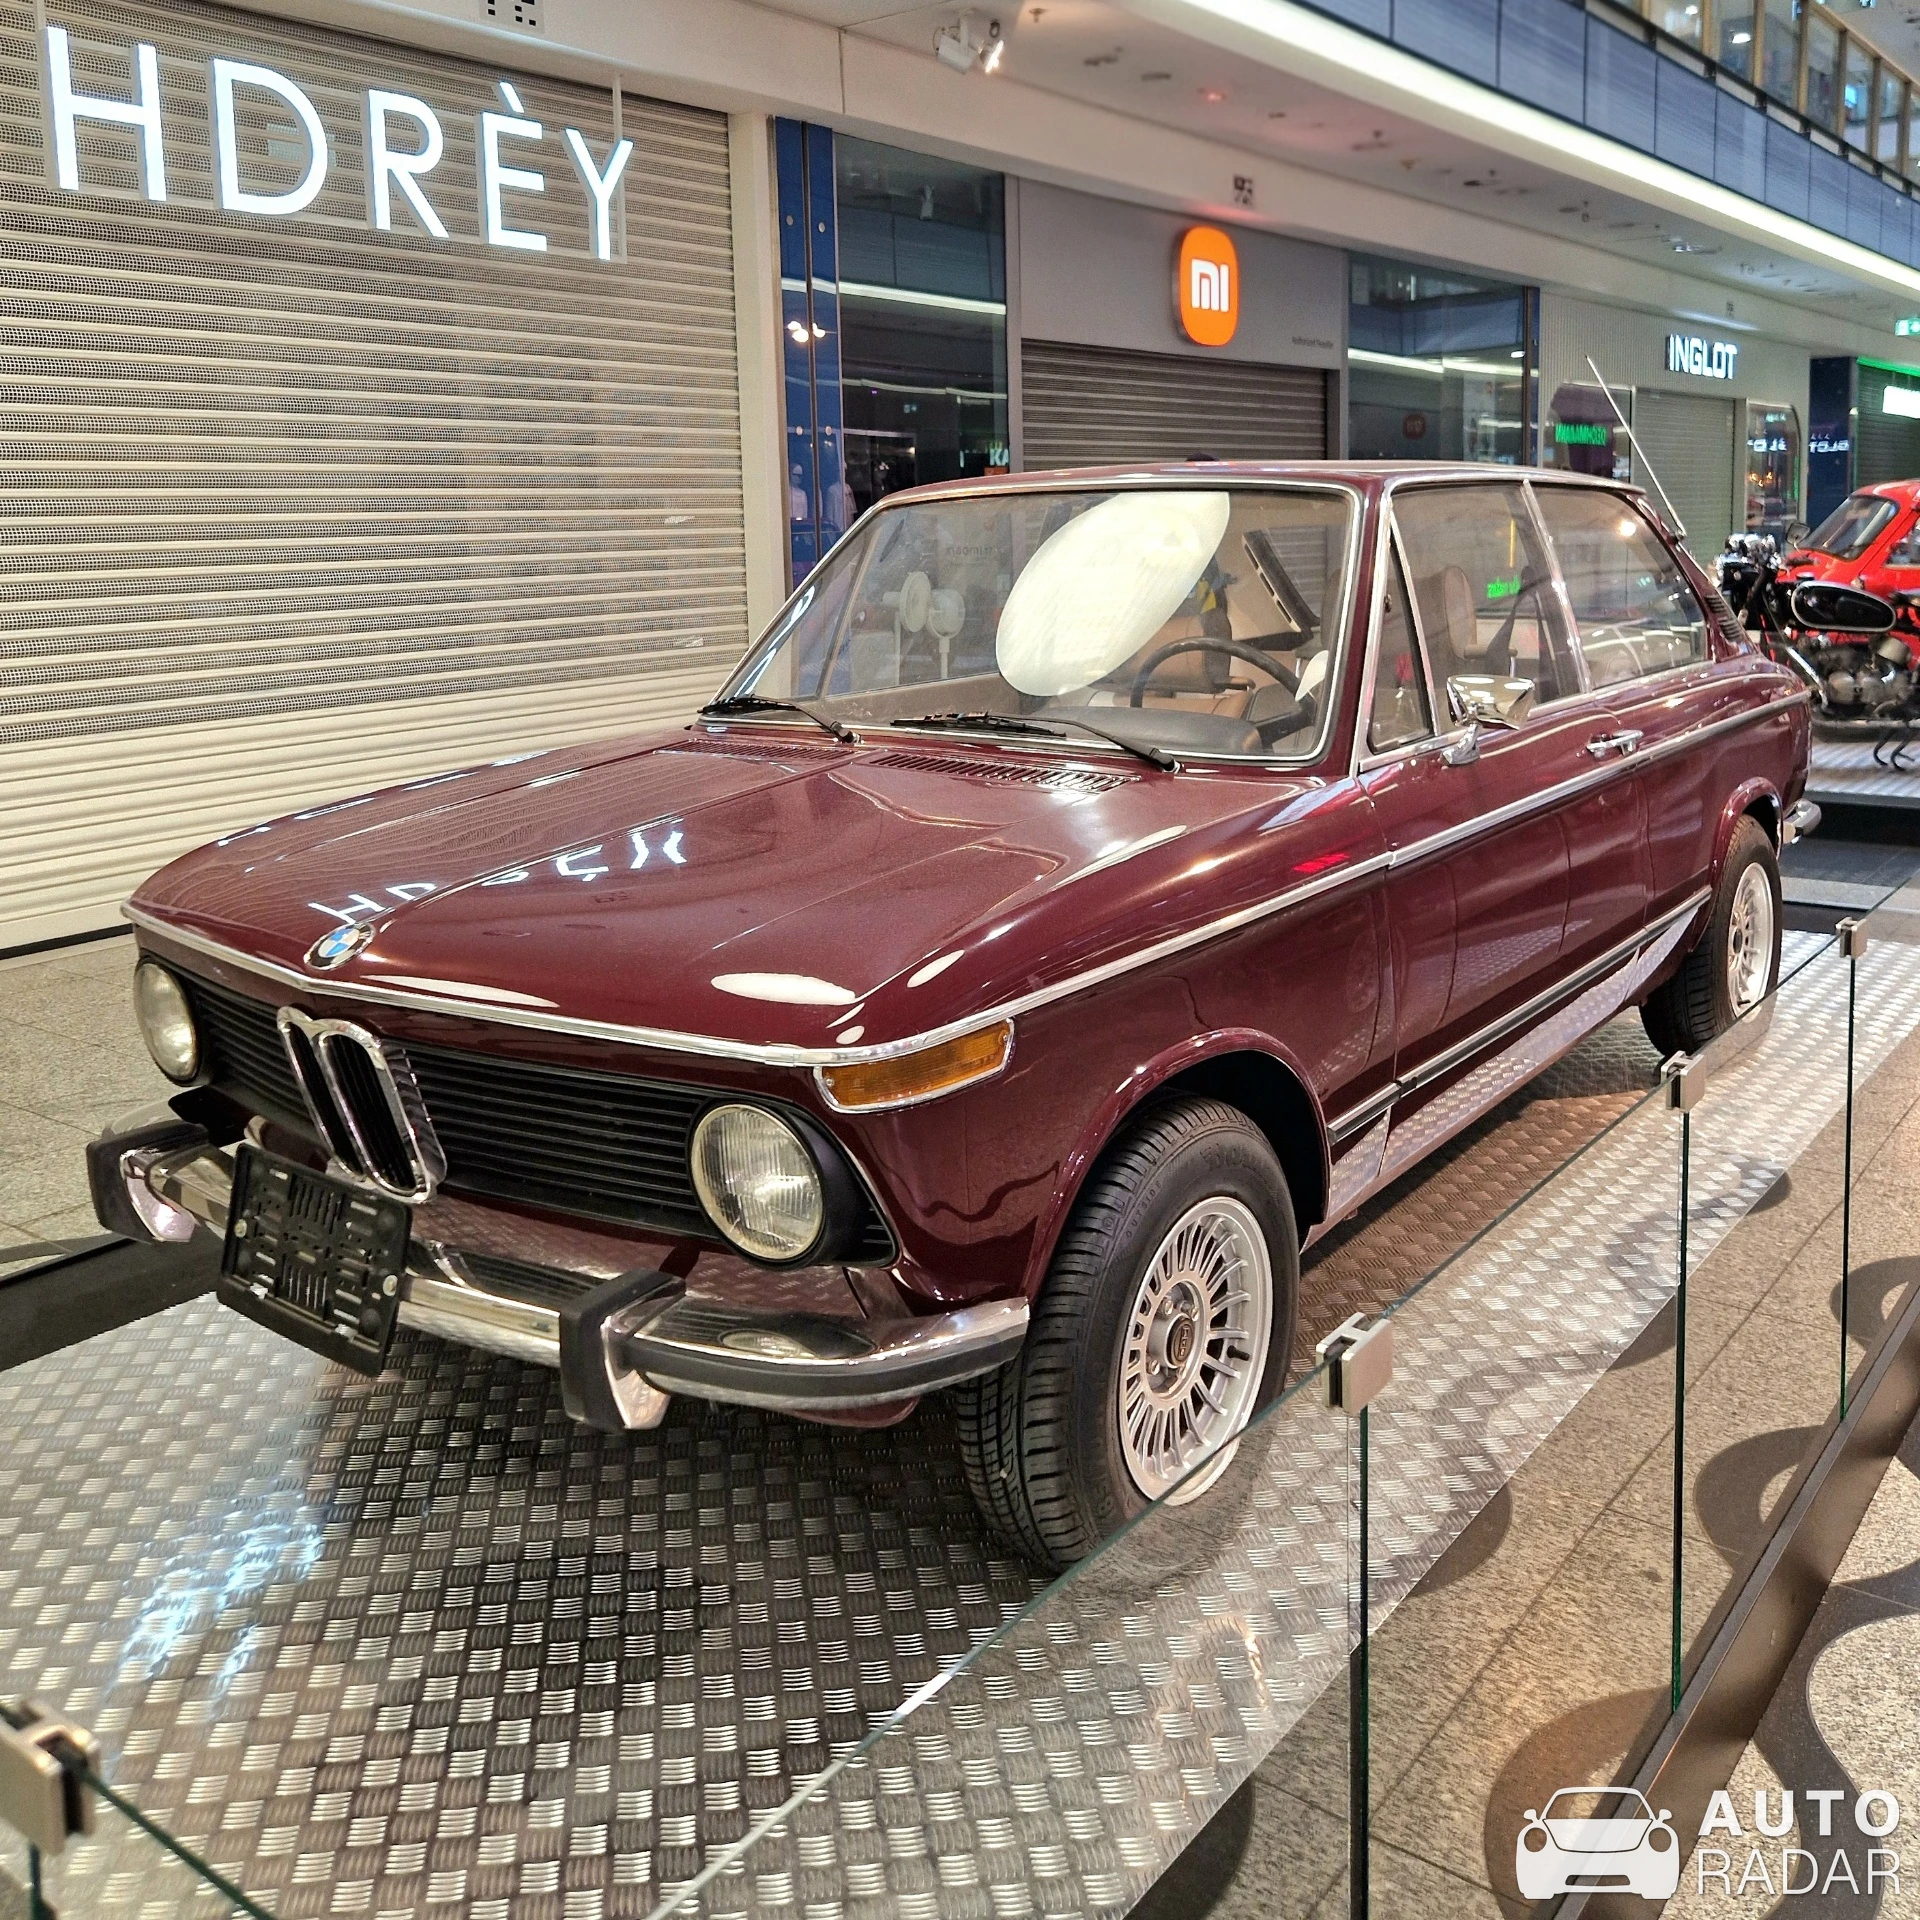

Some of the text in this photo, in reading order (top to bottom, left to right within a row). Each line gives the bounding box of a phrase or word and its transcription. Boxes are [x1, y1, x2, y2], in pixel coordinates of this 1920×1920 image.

[44, 26, 634, 261] HDRÈY
[1669, 333, 1738, 380] INGLOT
[1124, 1179, 1162, 1239] OUTSIDE
